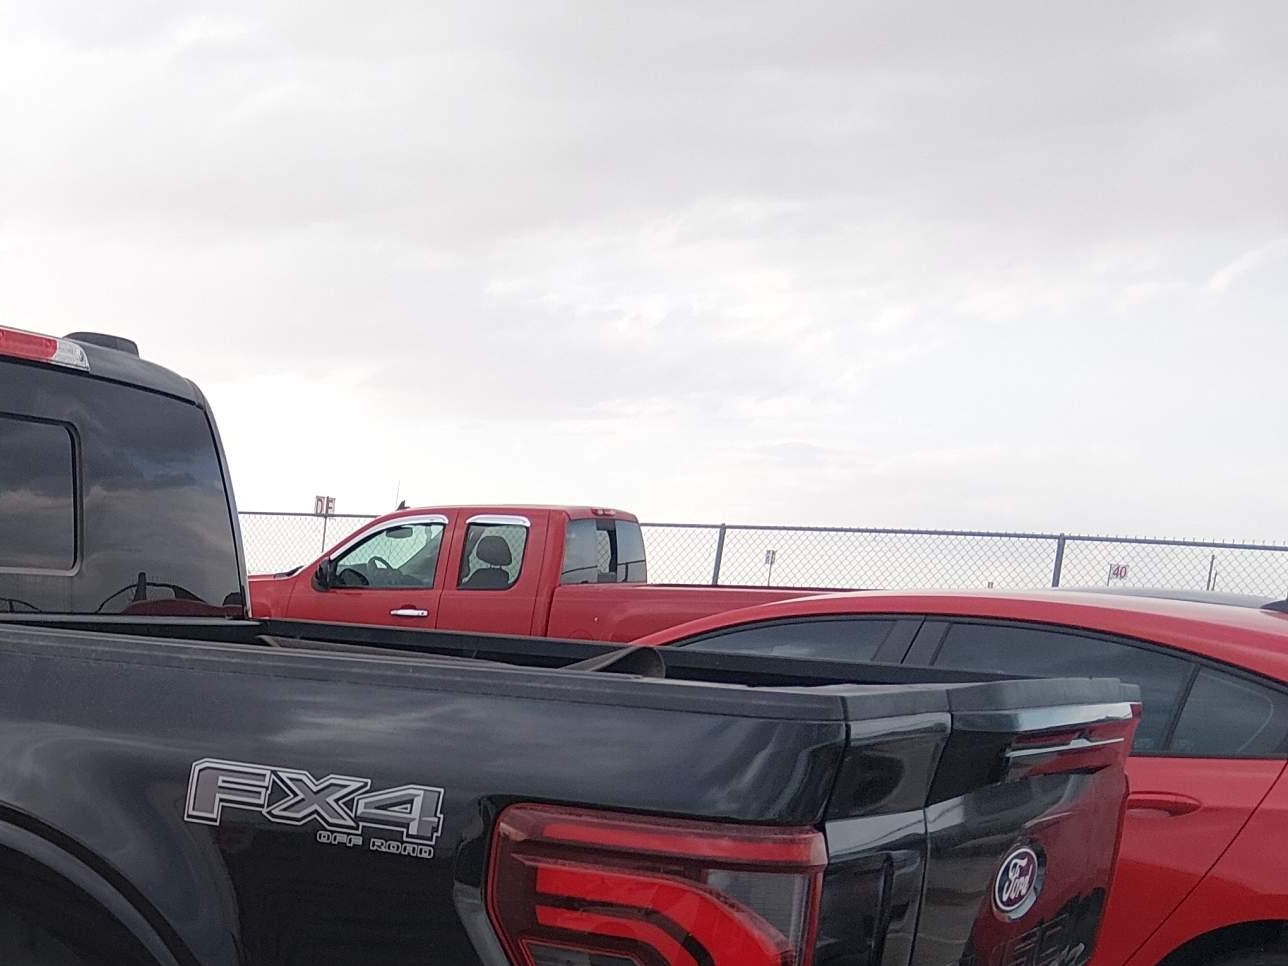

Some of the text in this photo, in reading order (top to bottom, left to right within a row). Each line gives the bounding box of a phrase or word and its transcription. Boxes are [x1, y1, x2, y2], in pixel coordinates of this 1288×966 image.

[184, 757, 444, 844] FX4
[316, 831, 434, 859] OFF ROAD
[1001, 856, 1034, 903] Ford
